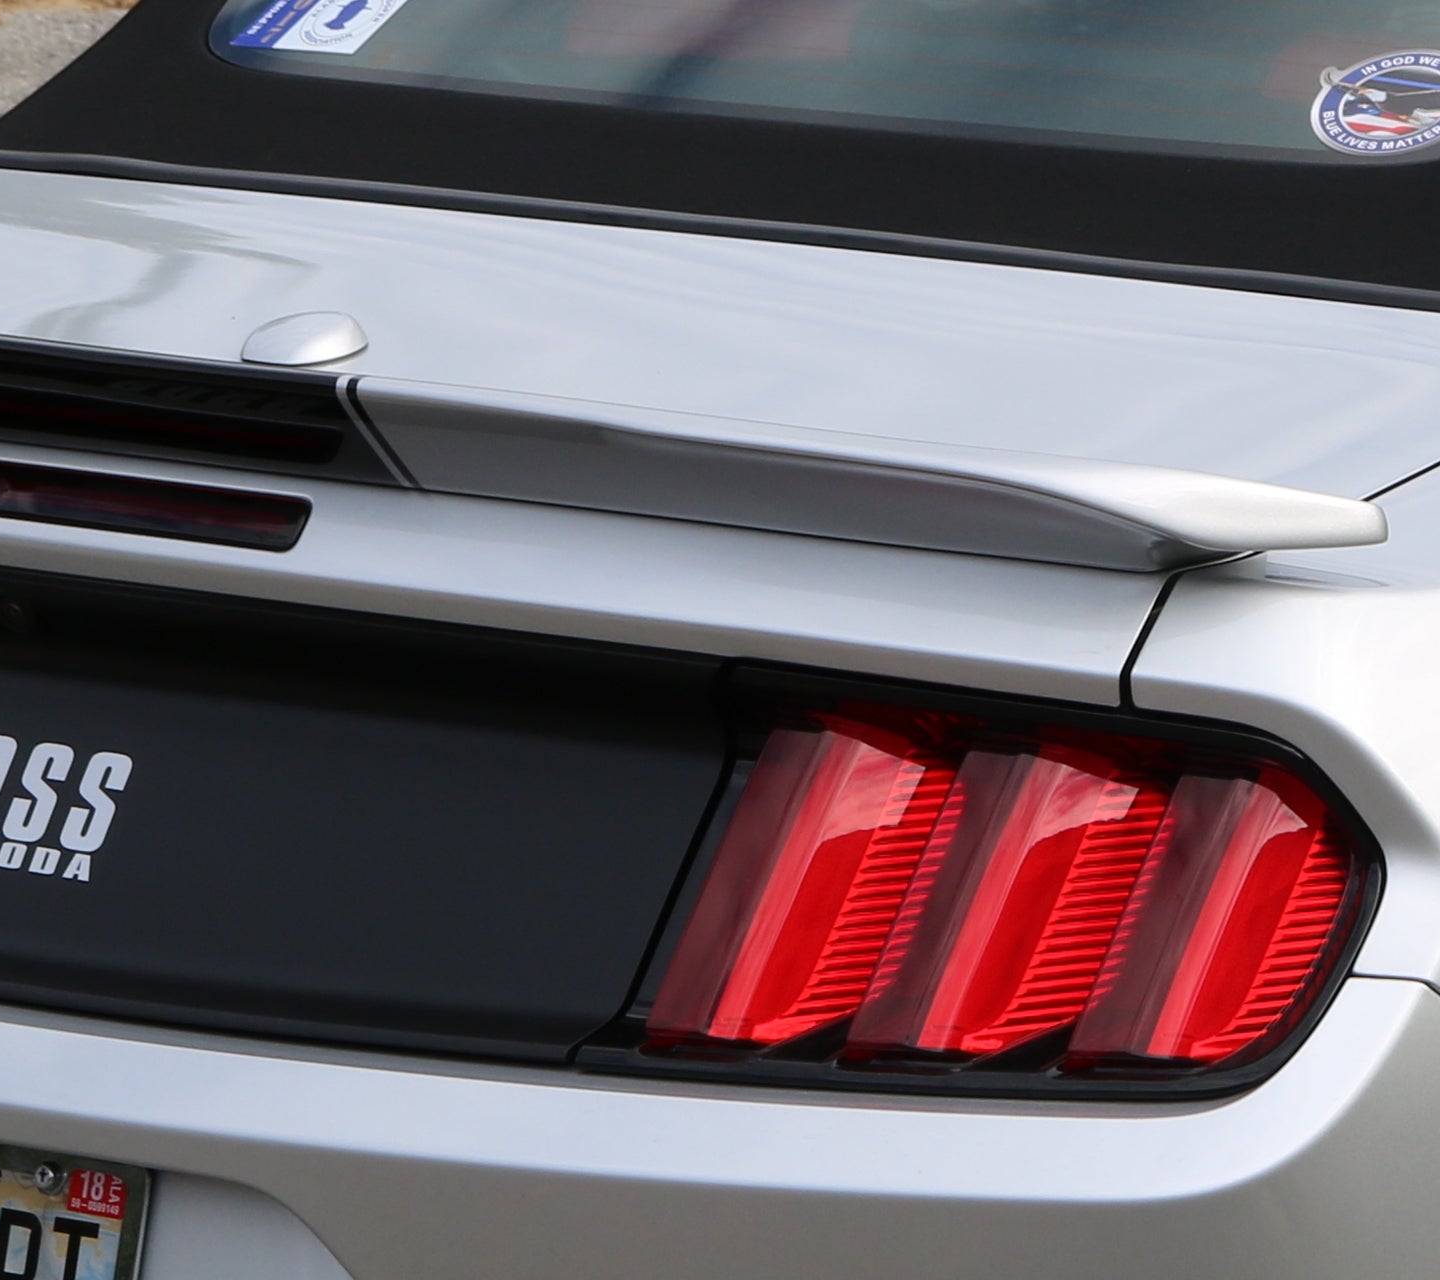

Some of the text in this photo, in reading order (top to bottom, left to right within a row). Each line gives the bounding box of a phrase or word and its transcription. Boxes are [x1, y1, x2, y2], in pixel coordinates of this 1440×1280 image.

[1361, 64, 1378, 76] IN
[1380, 56, 1415, 68] GOD
[1323, 110, 1340, 136] BLUE
[1337, 132, 1378, 150] LIVES
[81, 1170, 106, 1201] 18
[108, 1175, 123, 1203] ALA
